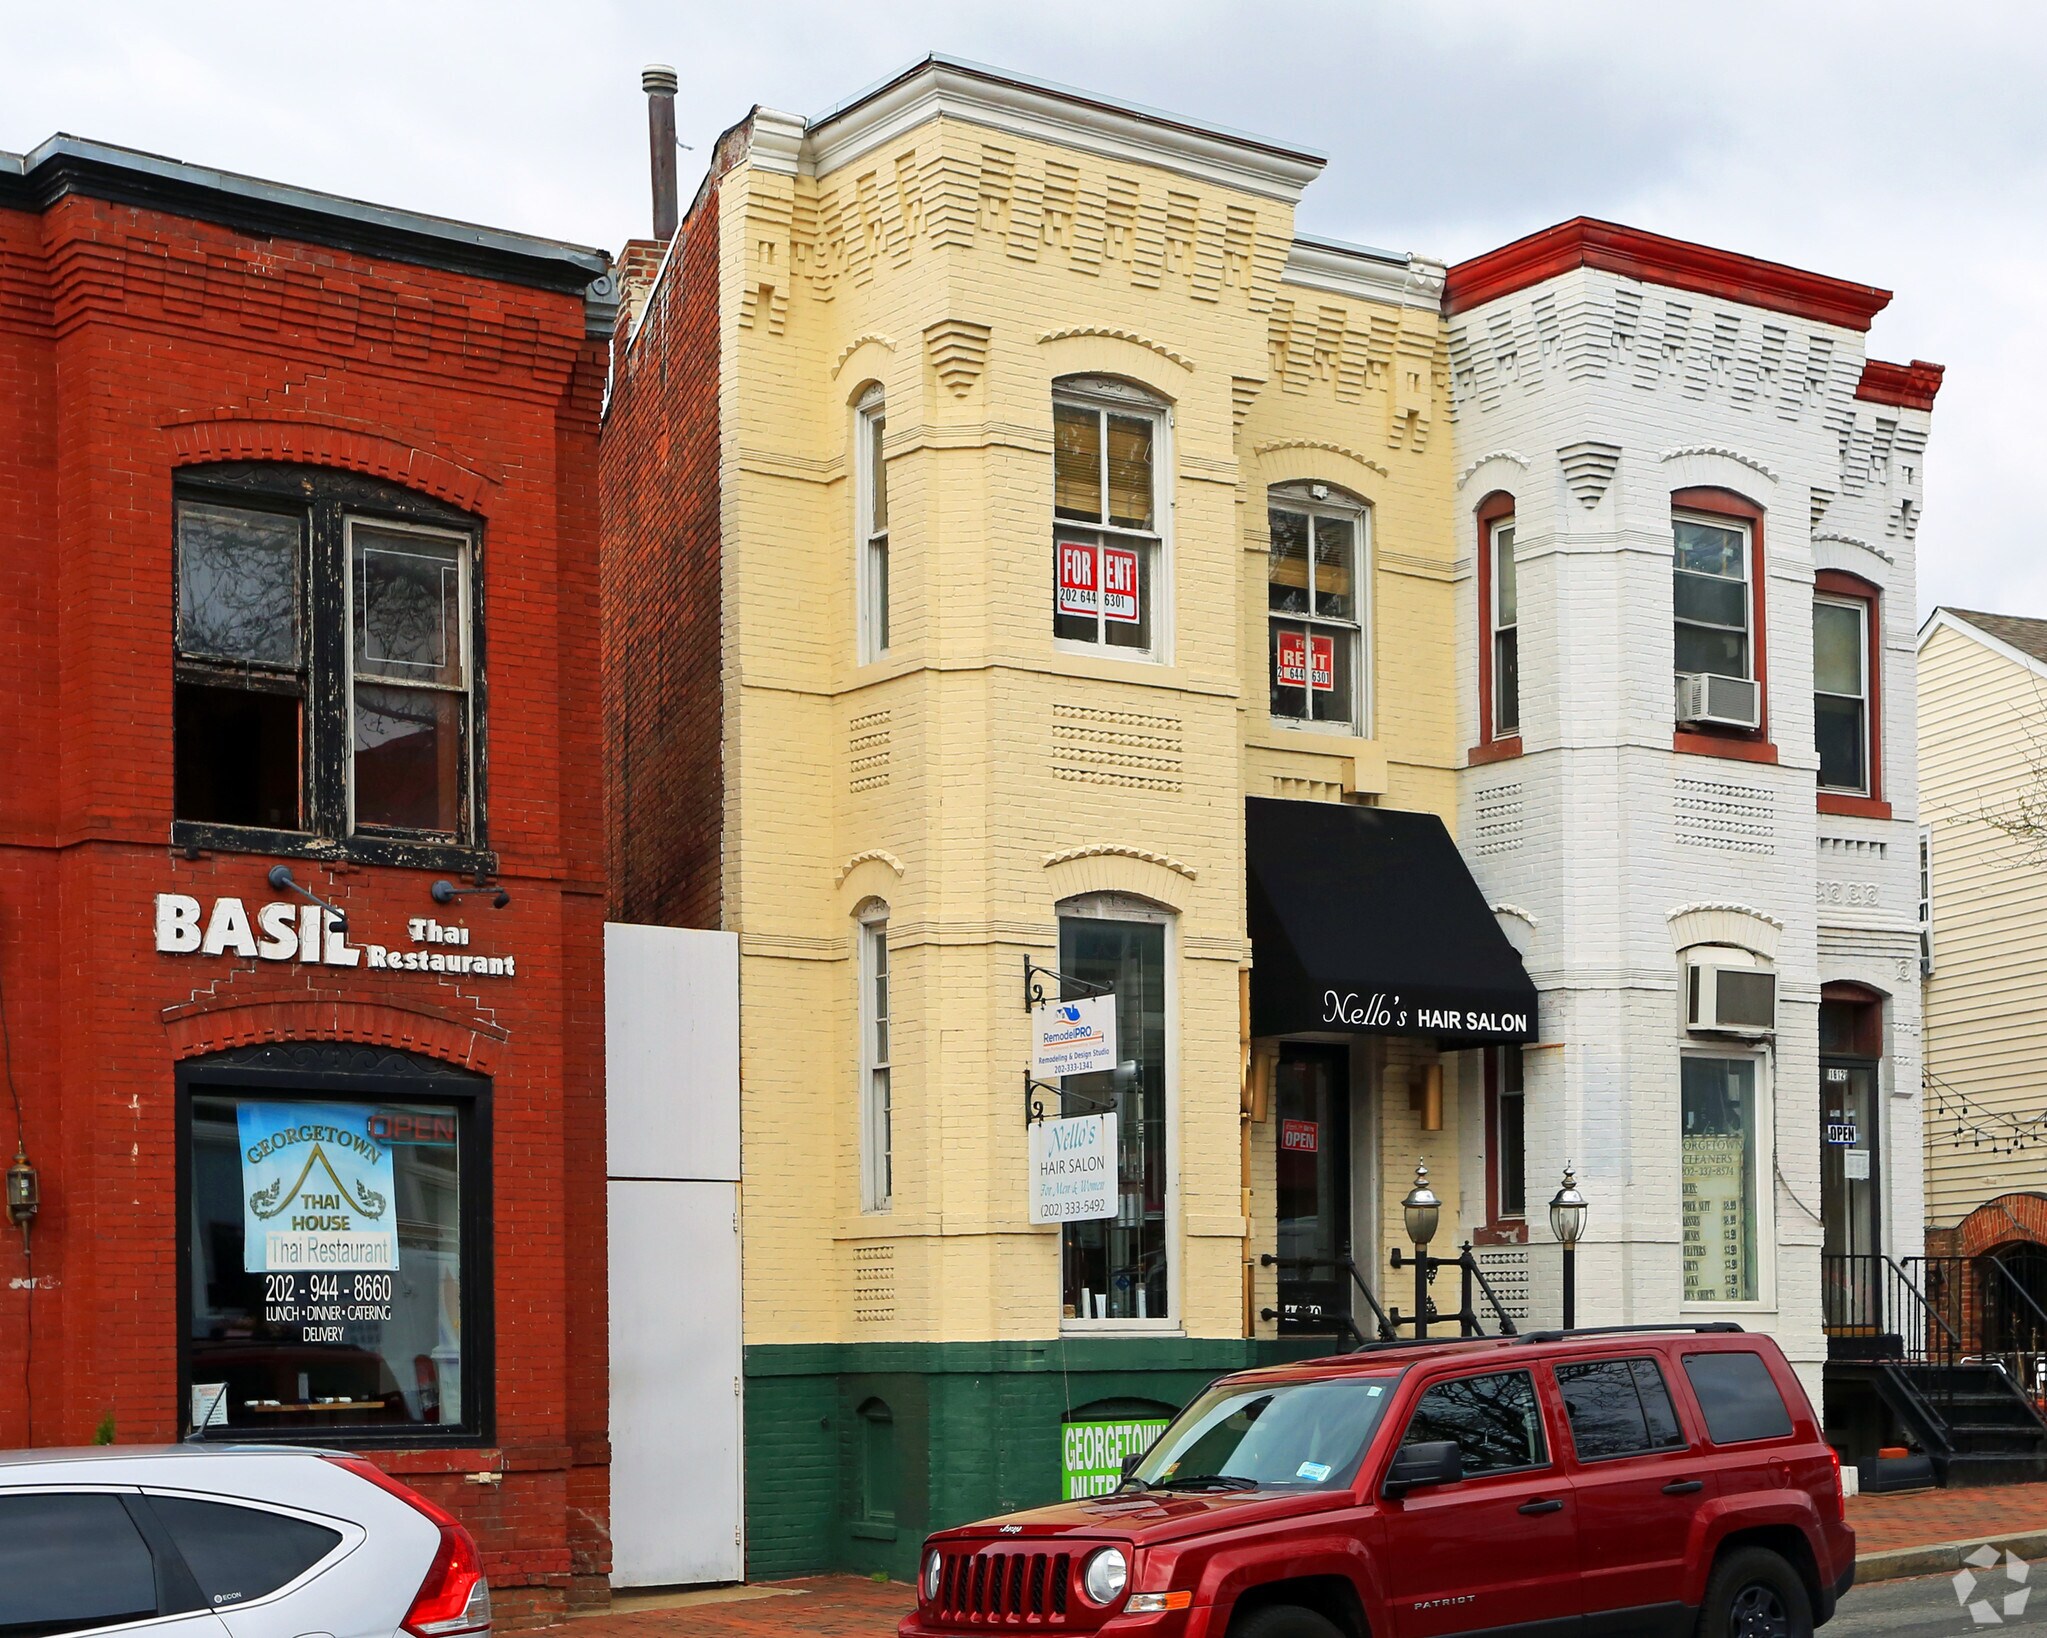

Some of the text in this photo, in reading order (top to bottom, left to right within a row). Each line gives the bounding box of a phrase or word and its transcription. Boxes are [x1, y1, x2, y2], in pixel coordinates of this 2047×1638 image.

[1063, 548, 1133, 592] FOR ENT
[1060, 587, 1125, 609] 202 644 6301
[1289, 667, 1304, 680] 644
[1311, 670, 1329, 684] 6301
[154, 892, 361, 966] BASIL
[408, 917, 470, 946] Thai
[366, 944, 516, 977] Restaurant
[1322, 989, 1528, 1033] Nello's HAIR SALON
[1038, 1053, 1068, 1065] Remodeling
[1073, 1050, 1092, 1062] Design
[1092, 1047, 1110, 1058] Studio
[1054, 1061, 1094, 1075] 202-333-1341
[368, 1114, 457, 1142] OPEN
[1829, 1125, 1855, 1141] OPEN
[246, 1124, 383, 1166] GEORGETOWN
[1047, 1119, 1097, 1159] Nello's
[1285, 1131, 1315, 1149] OPEN
[1040, 1155, 1105, 1176] HAIR SALON
[1682, 1154, 1734, 1165] CLEANERS
[300, 1193, 341, 1211] THAI
[1040, 1198, 1105, 1218] (202) 333-5492
[291, 1215, 352, 1232] HOUSE
[269, 1235, 389, 1264] Thai Restaurant
[264, 1273, 296, 1302] 202
[309, 1273, 340, 1302] 944
[353, 1273, 393, 1302] 8660
[265, 1304, 392, 1322] LUNCH DINNER CATERING
[302, 1326, 345, 1342] DELIVERY
[222, 1591, 242, 1601] ECON
[1414, 1594, 1476, 1610] PATRIOT
